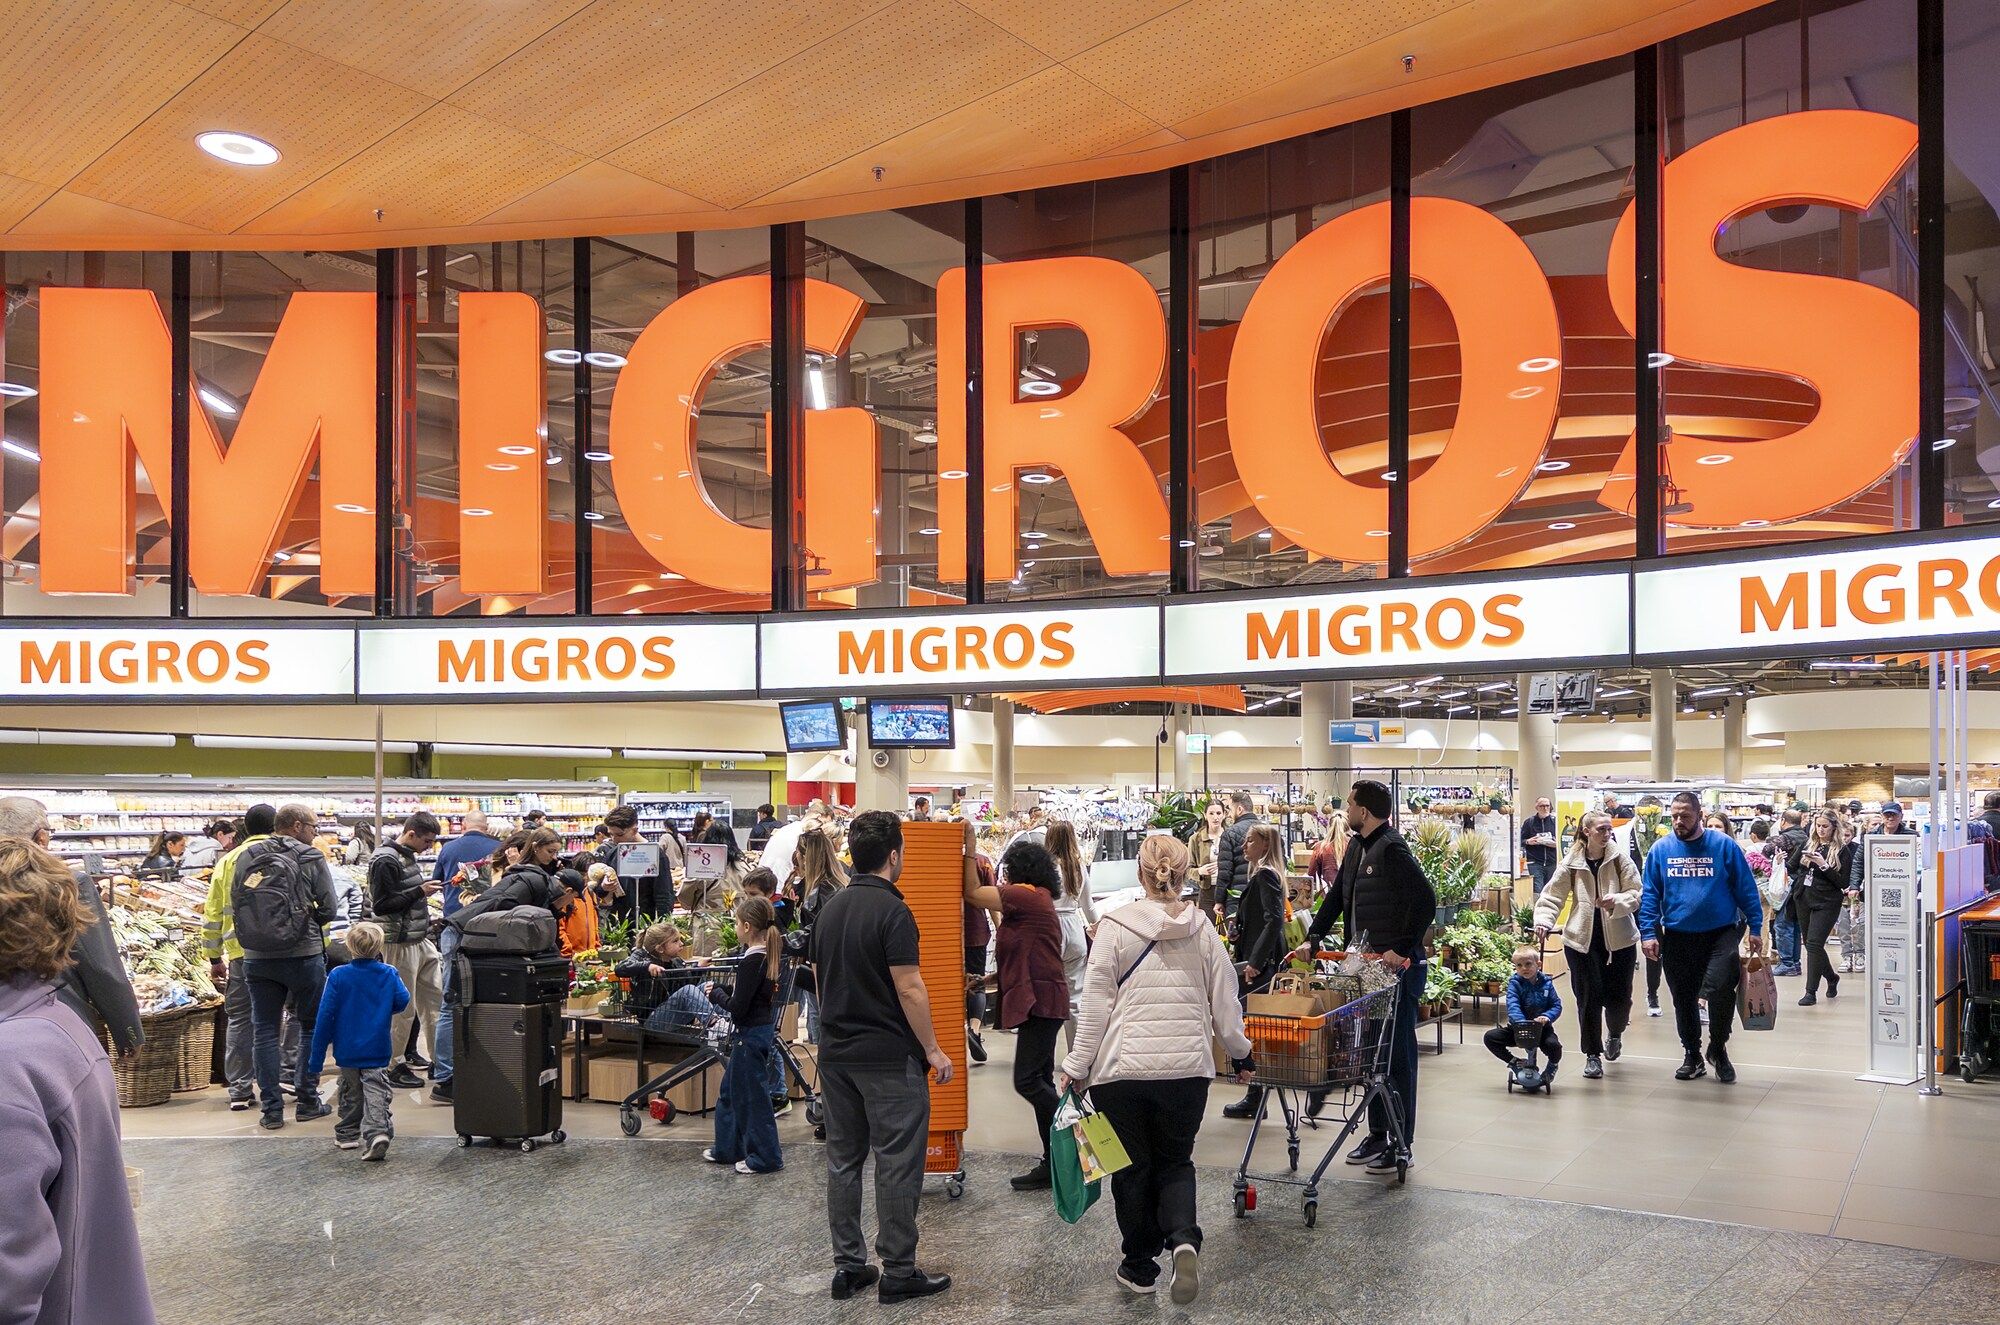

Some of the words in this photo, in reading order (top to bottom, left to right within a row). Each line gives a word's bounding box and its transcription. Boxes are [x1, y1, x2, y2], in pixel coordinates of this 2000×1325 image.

[38, 108, 1922, 598] MIGROS
[840, 624, 1075, 676] MIGROS
[1248, 594, 1525, 662] MIGROS
[21, 640, 271, 685] MIGROS
[438, 637, 676, 684] MIGROS
[702, 852, 711, 866] 8
[1667, 867, 1714, 877] KLOTEN
